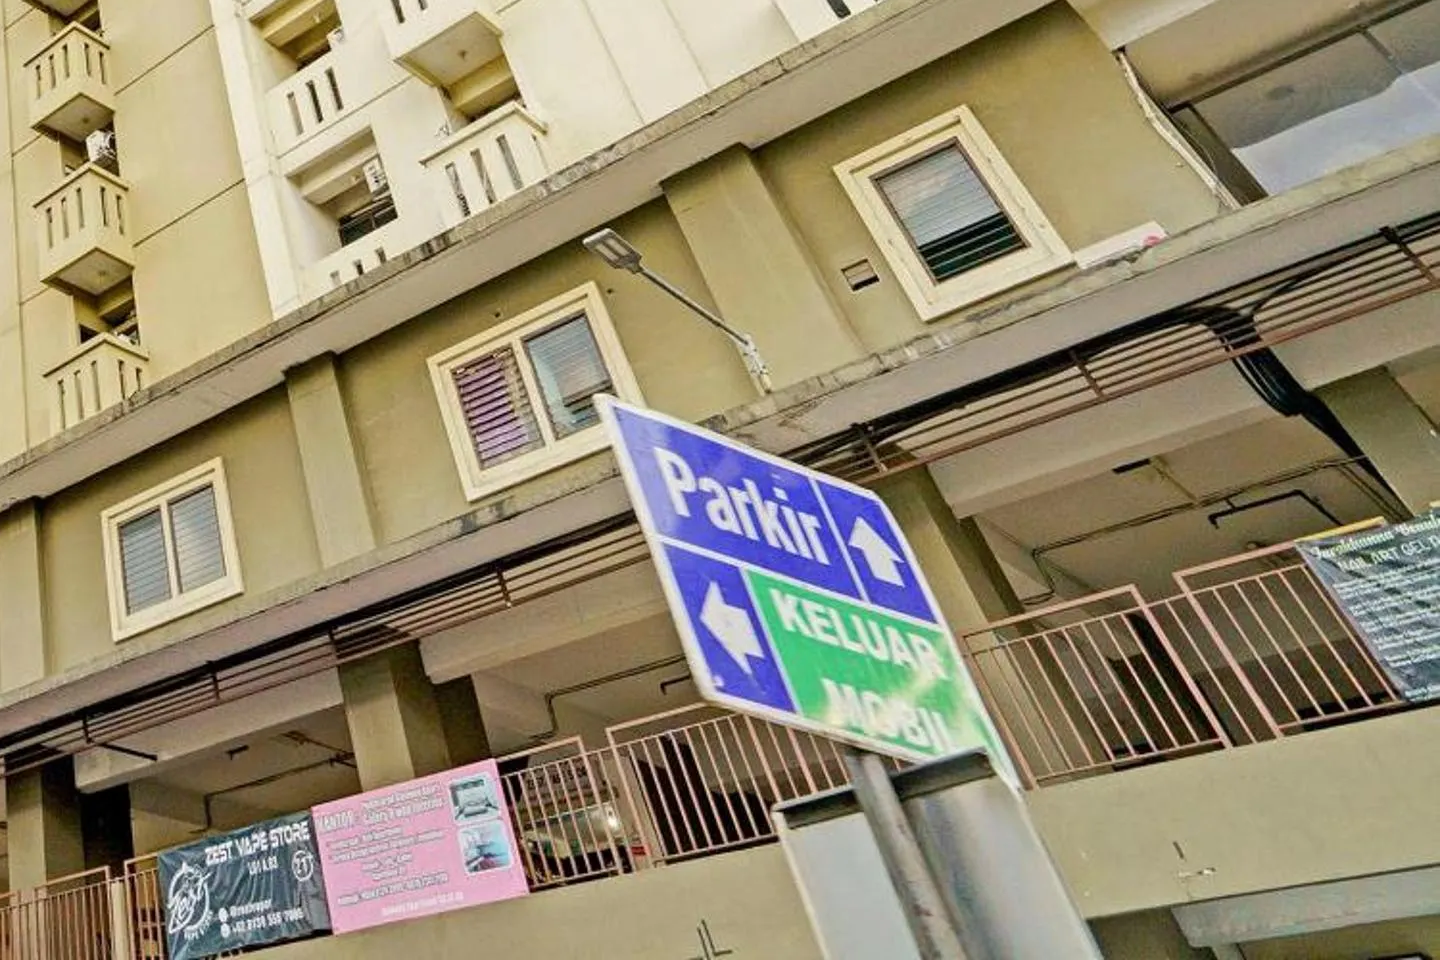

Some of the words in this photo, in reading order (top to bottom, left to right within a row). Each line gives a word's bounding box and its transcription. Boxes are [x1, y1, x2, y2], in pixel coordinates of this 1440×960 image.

[654, 447, 830, 566] Parkir
[771, 592, 949, 680] KELUAR
[205, 840, 233, 866] ZEST
[235, 831, 269, 857] VAPE
[269, 820, 311, 848] STORE
